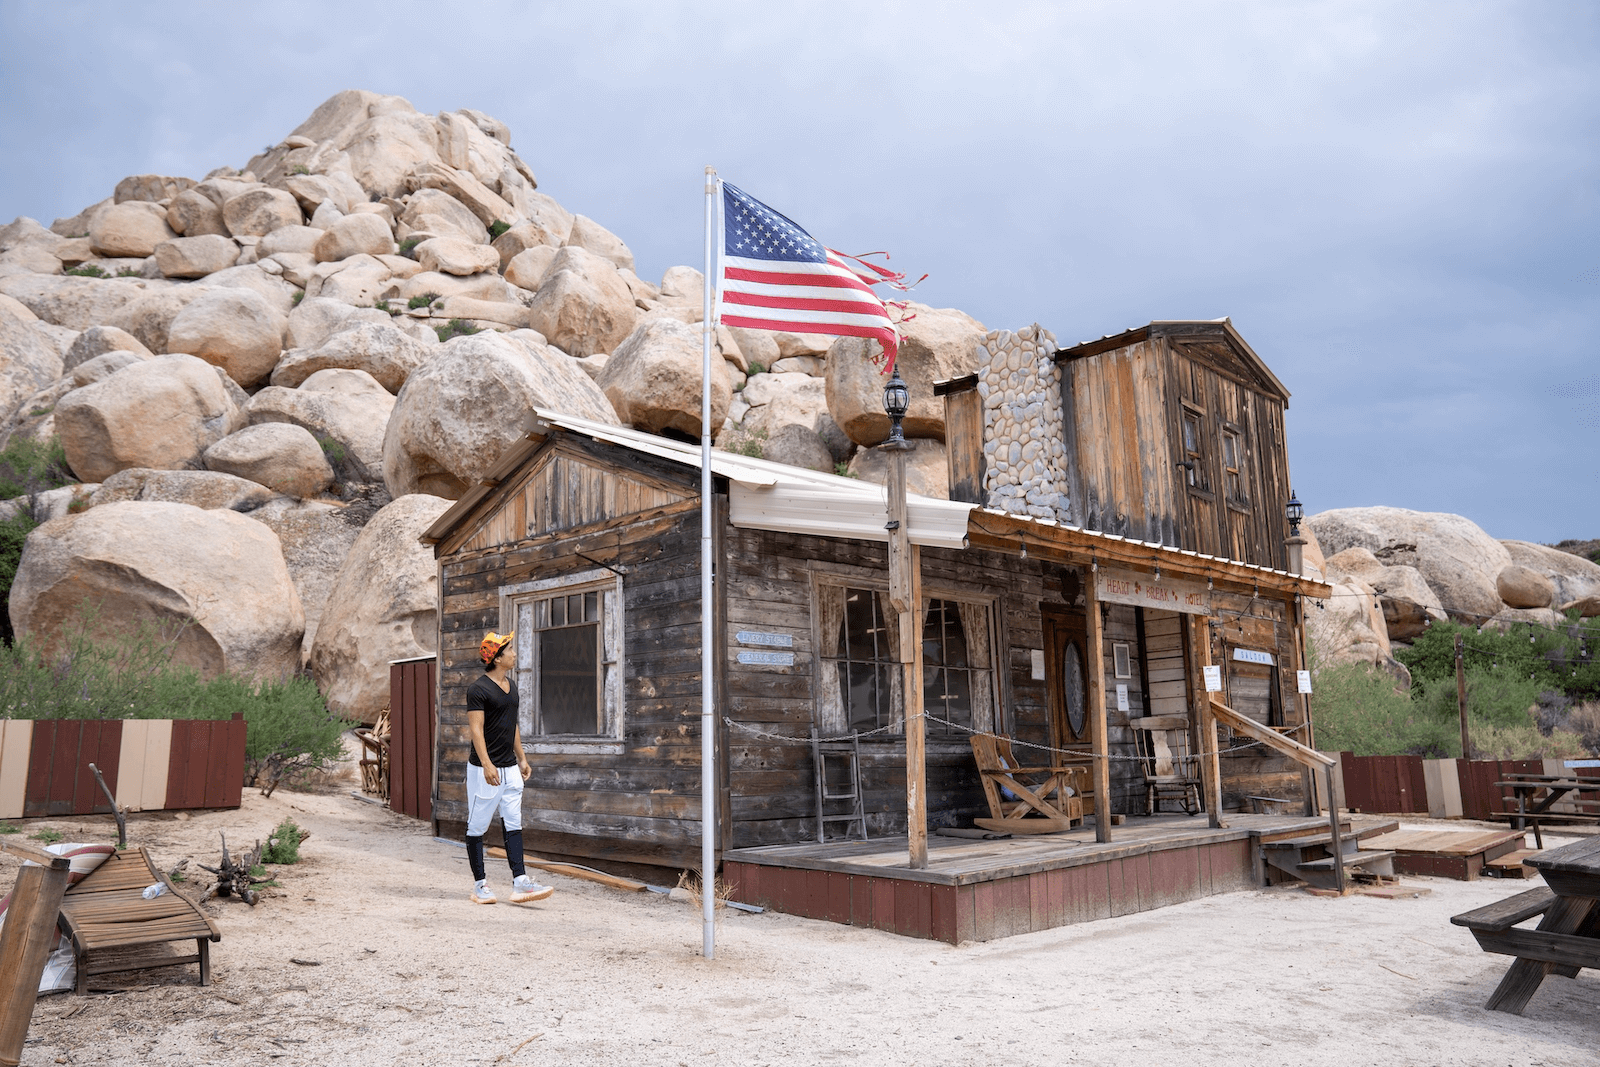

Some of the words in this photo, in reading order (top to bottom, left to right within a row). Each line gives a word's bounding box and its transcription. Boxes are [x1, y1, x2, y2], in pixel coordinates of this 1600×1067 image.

[1106, 579, 1129, 595] HEART
[1146, 586, 1169, 601] BREAK
[1184, 592, 1204, 605] HOTEL
[742, 633, 763, 643] LIVERY
[766, 635, 788, 645] STABLE
[742, 653, 770, 662] GENERAL
[1241, 651, 1265, 661] SALOON
